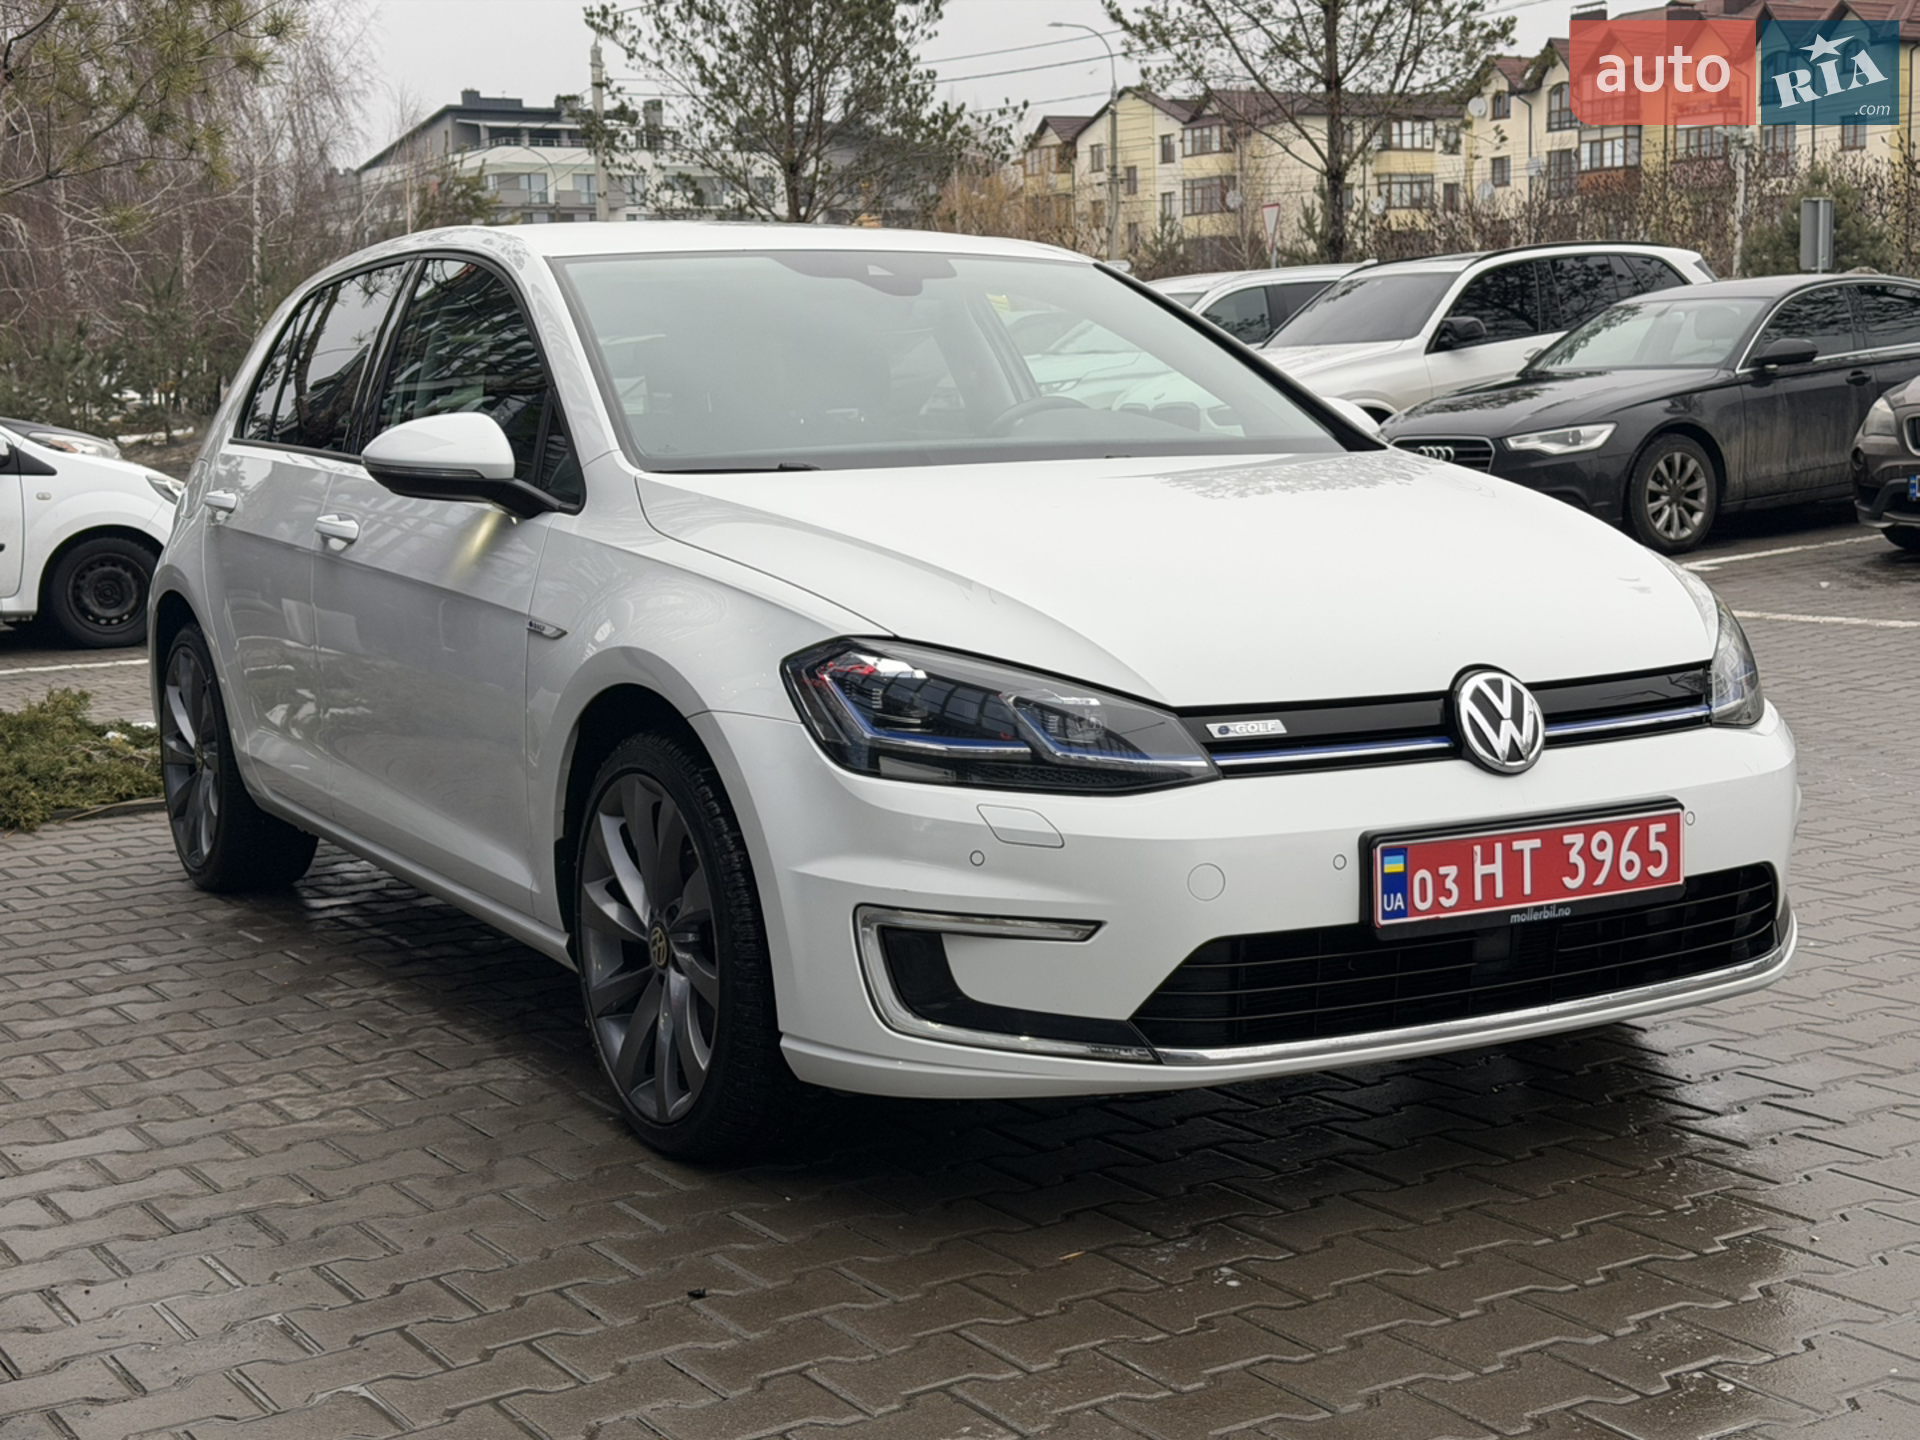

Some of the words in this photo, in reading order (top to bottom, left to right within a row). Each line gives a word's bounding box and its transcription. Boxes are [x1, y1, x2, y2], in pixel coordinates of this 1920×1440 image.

[1412, 865, 1460, 911] 03
[1473, 838, 1542, 902] HT
[1562, 822, 1669, 890] 3965
[1383, 892, 1405, 912] UA
[1510, 904, 1571, 924] mollerbil.no
